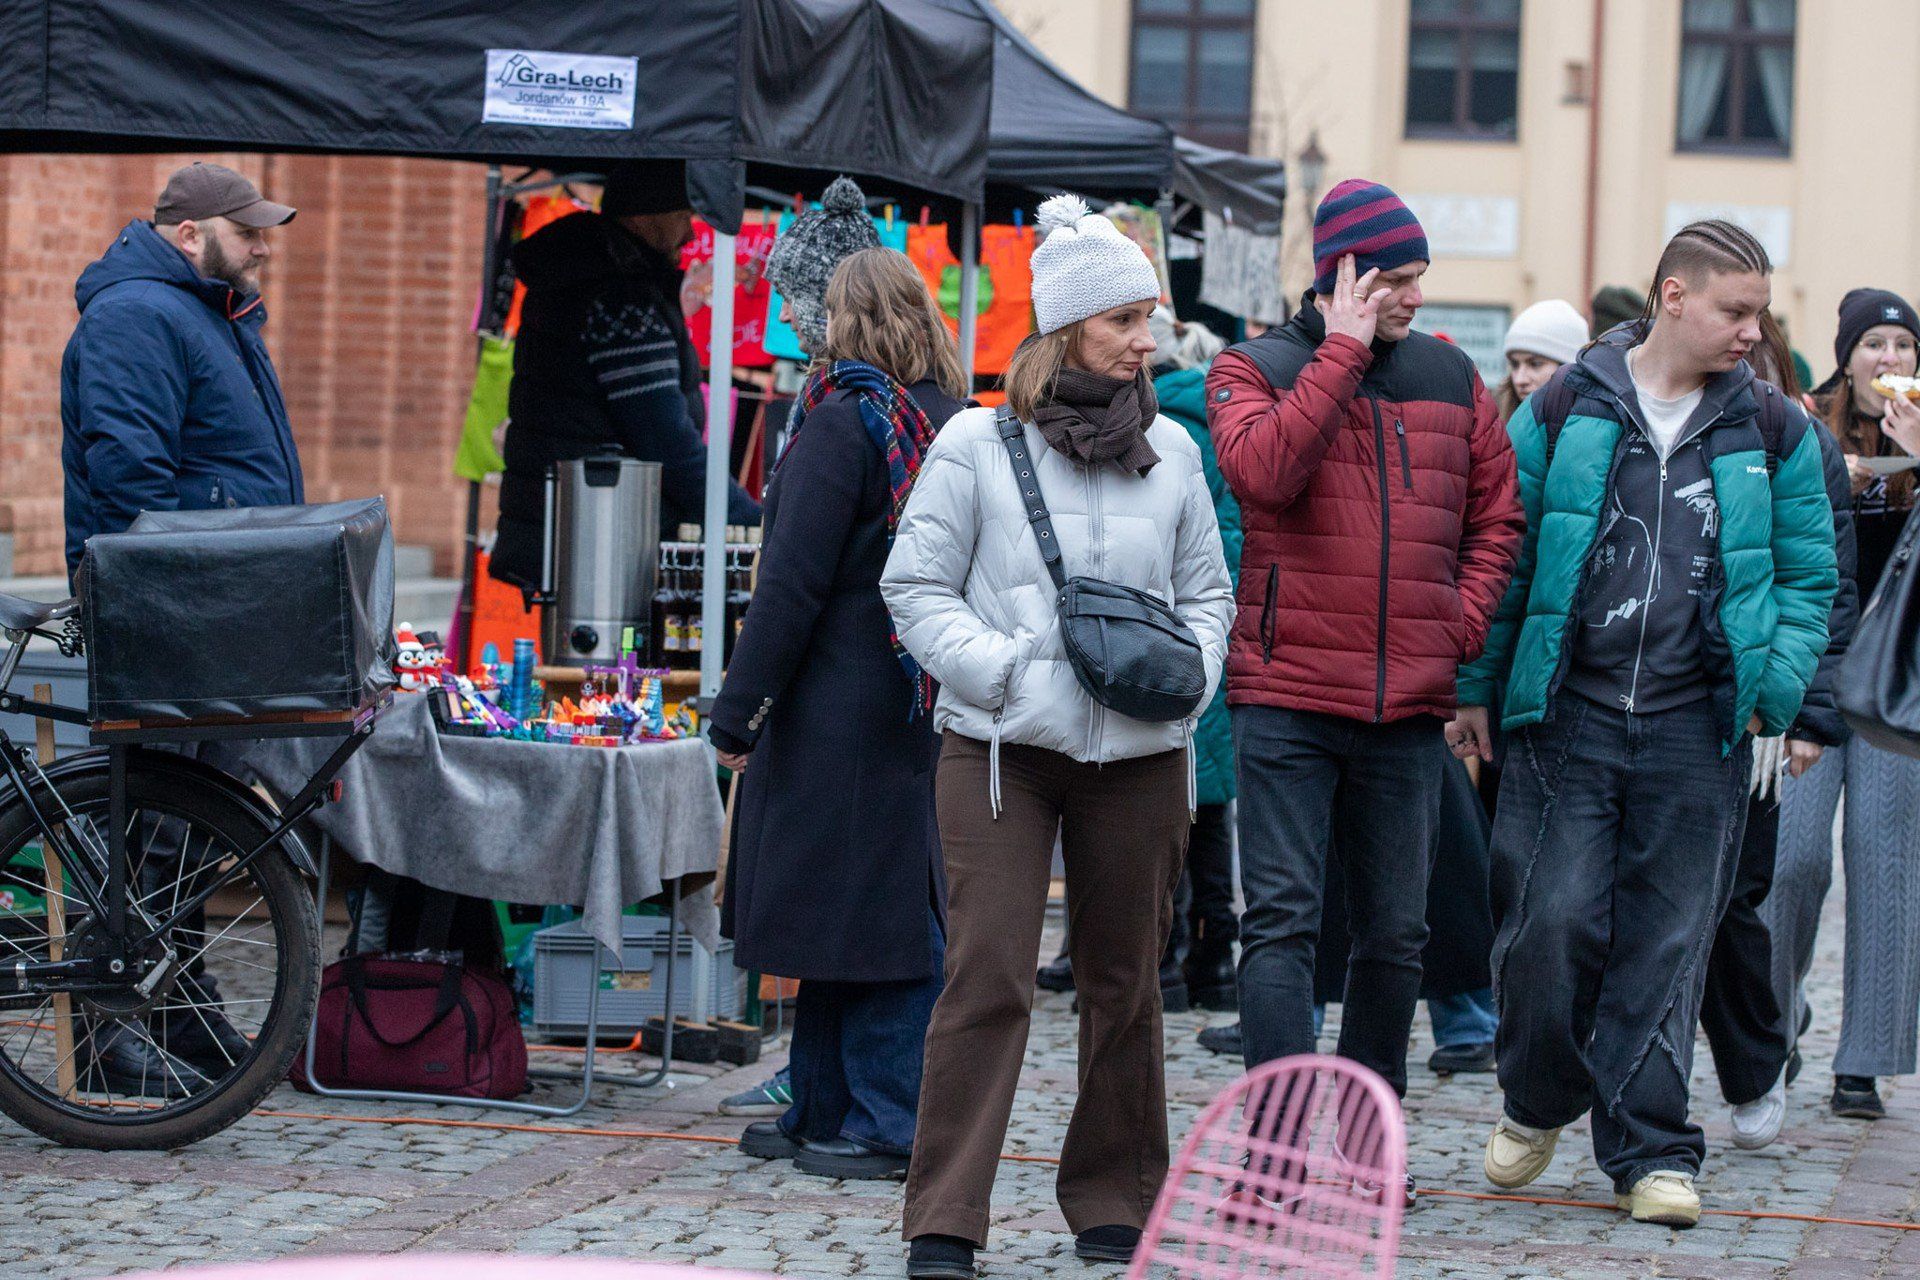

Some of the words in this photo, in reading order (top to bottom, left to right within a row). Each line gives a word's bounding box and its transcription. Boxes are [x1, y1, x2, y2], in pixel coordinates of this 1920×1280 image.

[517, 67, 622, 88] Gra-Lech
[515, 90, 577, 105] Jordanów
[582, 94, 605, 108] 19A
